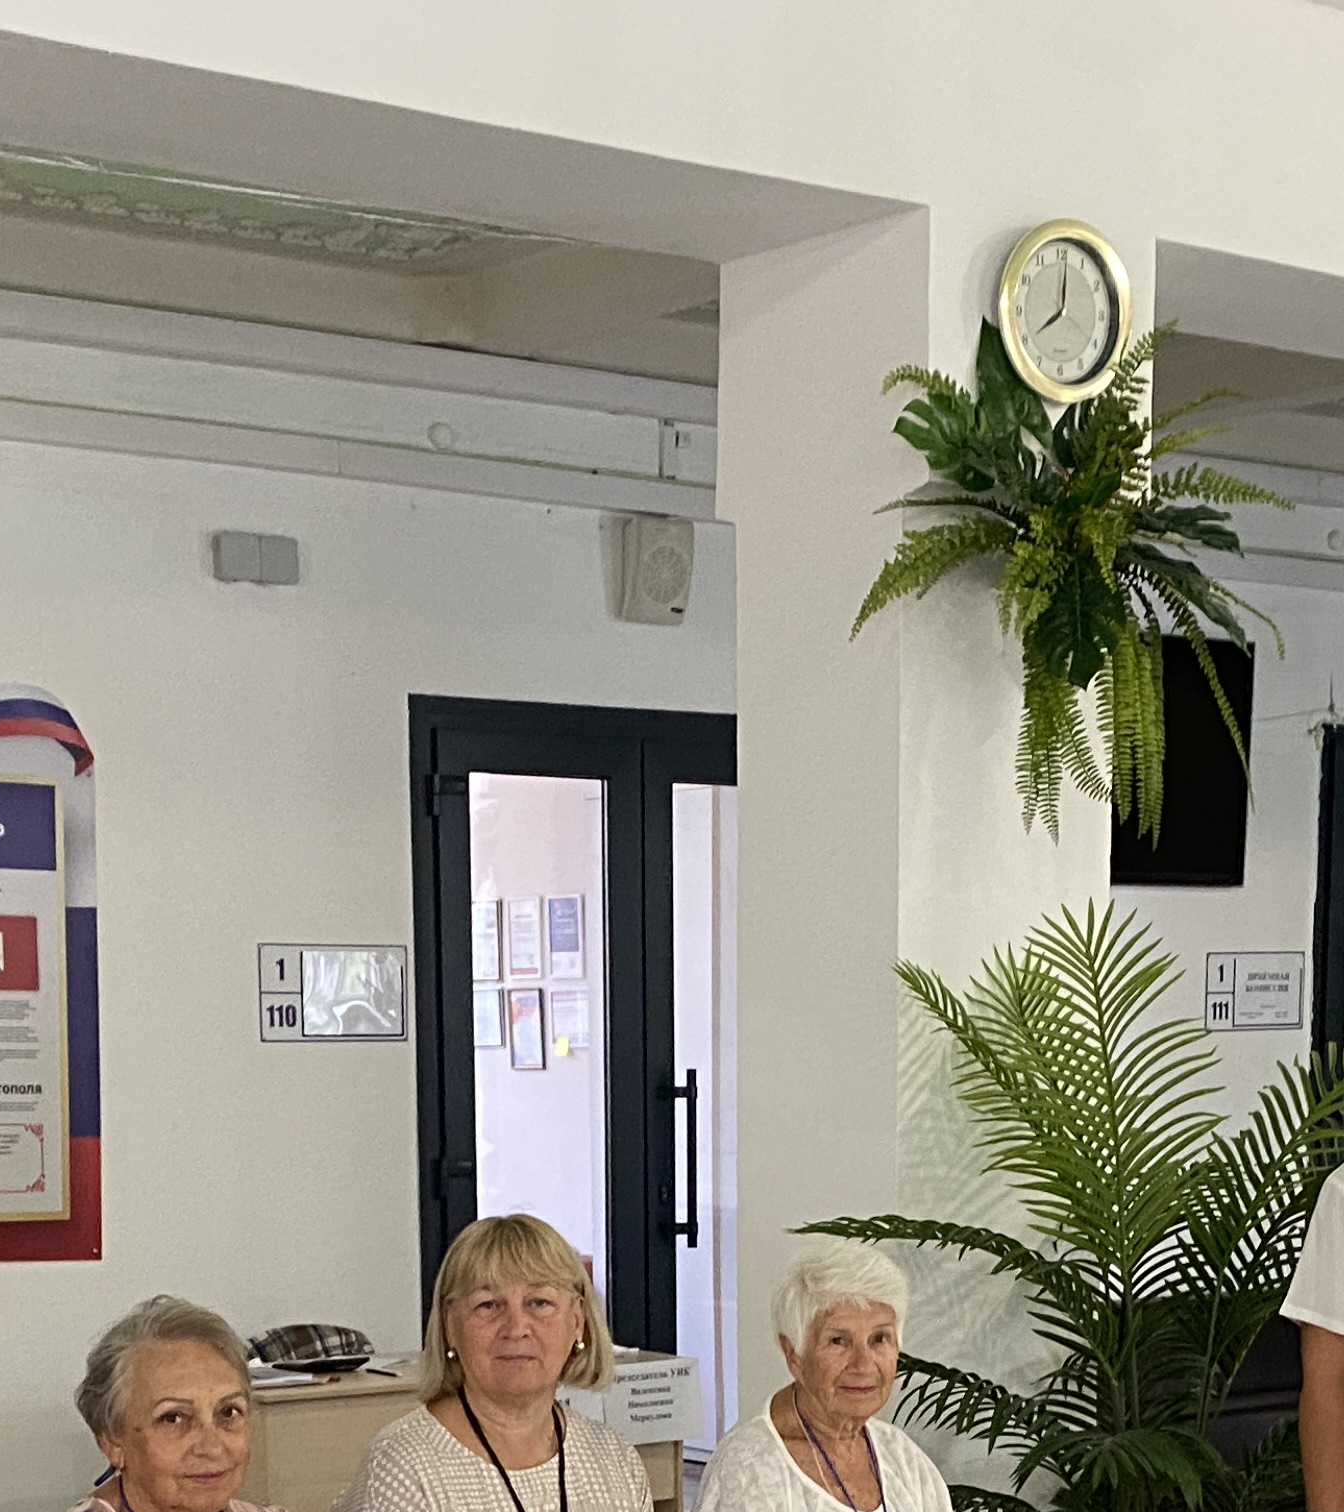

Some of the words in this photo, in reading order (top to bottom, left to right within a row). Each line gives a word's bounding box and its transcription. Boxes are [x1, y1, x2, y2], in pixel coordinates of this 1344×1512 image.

[1036, 254, 1044, 266] 11
[1056, 249, 1068, 260] 12
[1080, 258, 1084, 270] 1
[1093, 280, 1100, 292] 2
[275, 958, 285, 981] 1
[1218, 964, 1224, 982] 1
[266, 1004, 297, 1027] 110
[1211, 1001, 1229, 1020] 111
